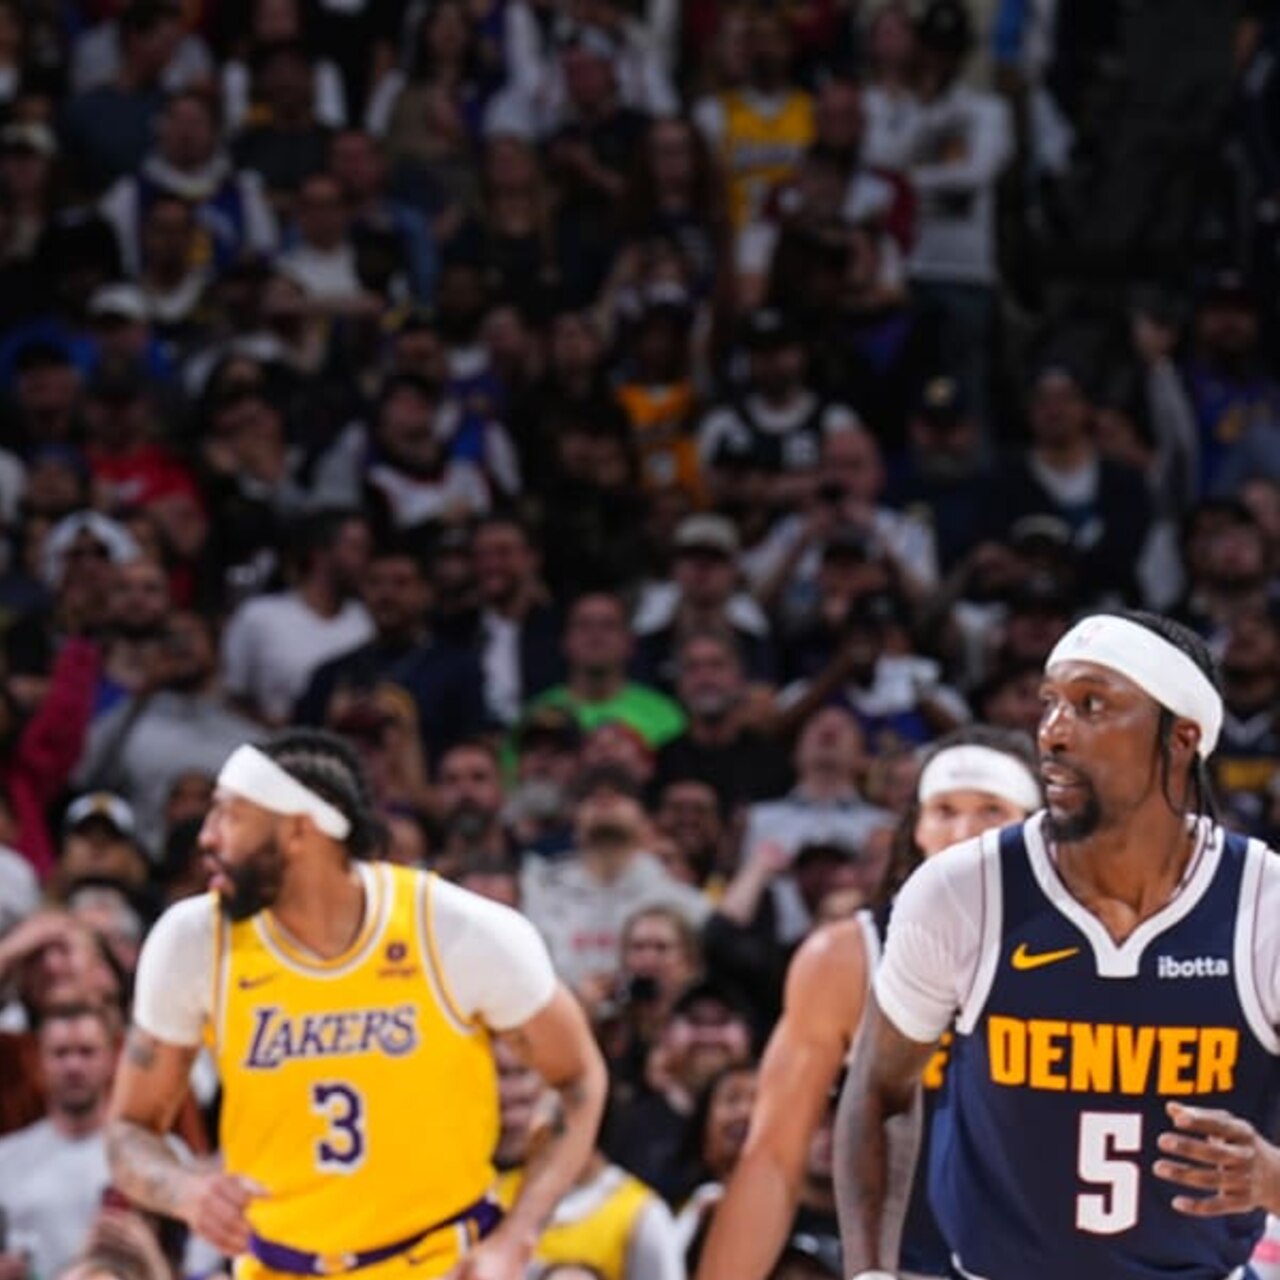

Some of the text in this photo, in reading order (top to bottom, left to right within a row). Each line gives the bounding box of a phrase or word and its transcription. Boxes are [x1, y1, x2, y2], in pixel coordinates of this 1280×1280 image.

[1157, 954, 1229, 980] ibotta
[243, 1003, 420, 1071] LAKERS
[987, 1016, 1239, 1096] DENVER
[311, 1081, 366, 1174] 3
[1075, 1110, 1144, 1236] 5
